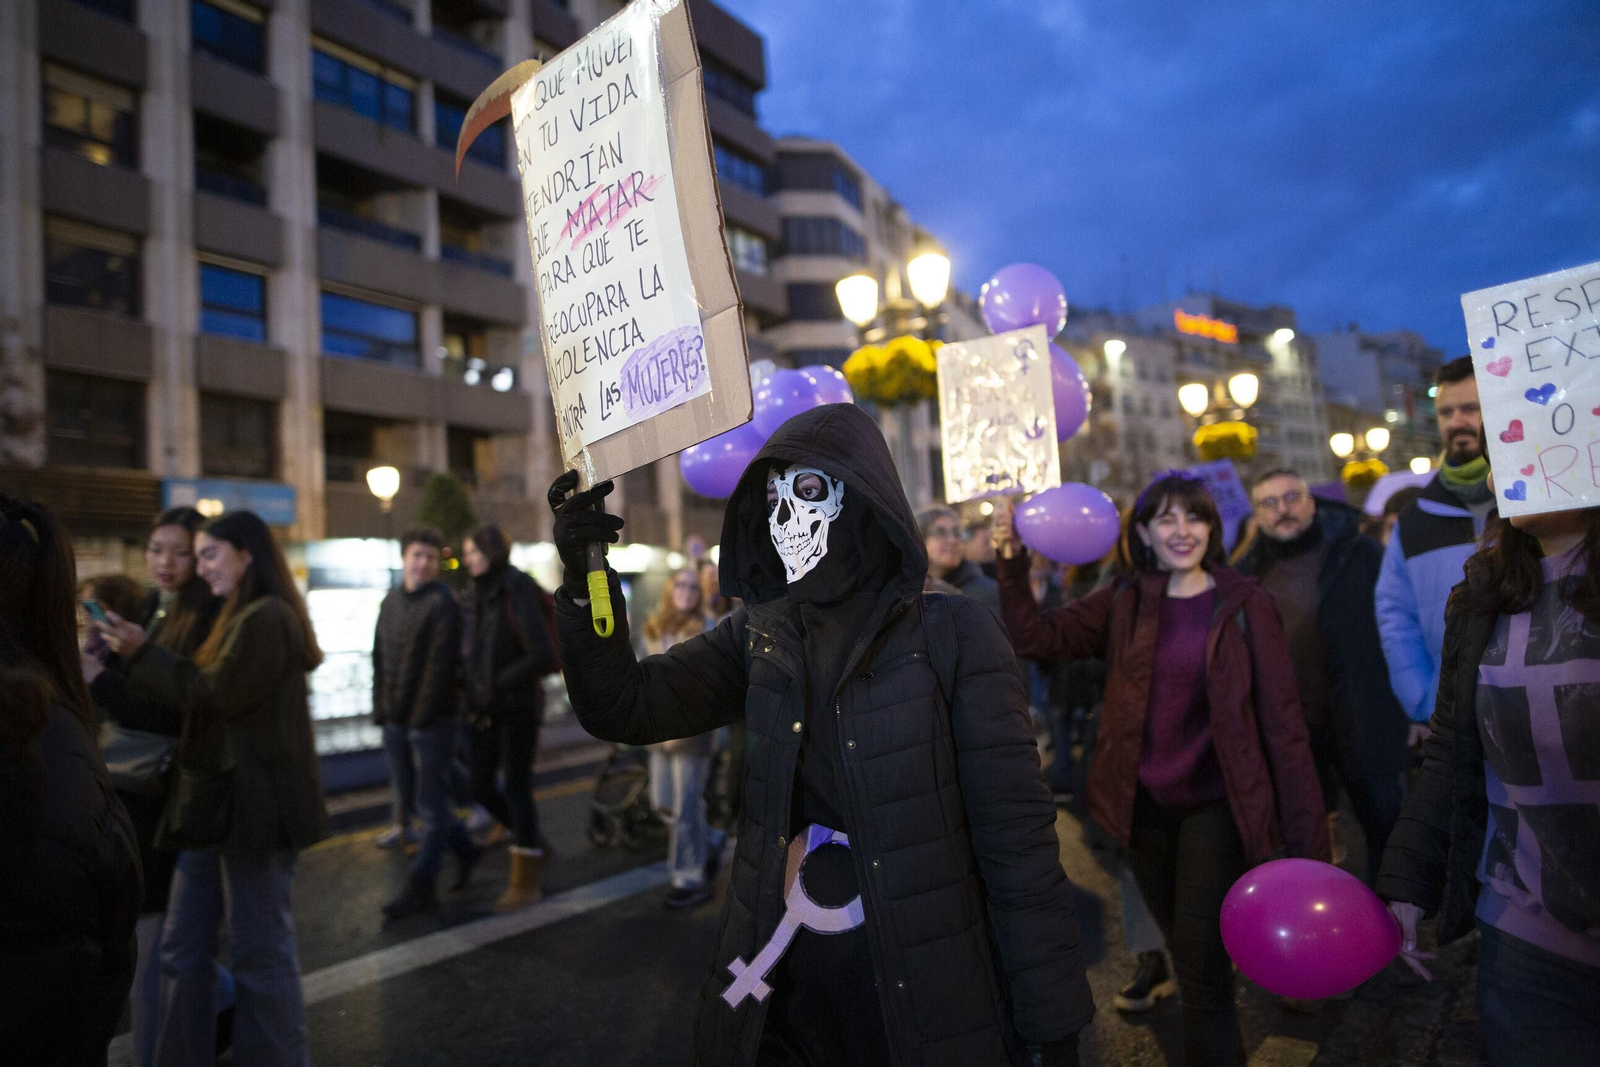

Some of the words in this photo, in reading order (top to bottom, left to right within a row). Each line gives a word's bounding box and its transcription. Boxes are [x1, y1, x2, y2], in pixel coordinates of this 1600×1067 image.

[534, 57, 566, 111] QUÉ
[538, 116, 559, 152] TU
[569, 73, 638, 133] VIDA
[527, 131, 624, 219] TENDRÍAN
[566, 170, 655, 239] MATAR
[540, 254, 577, 304] PARA
[582, 231, 614, 275] QUE
[623, 218, 649, 252] TE
[638, 264, 665, 301] LA
[1491, 277, 1600, 337] RESP
[551, 317, 646, 391] VIOLENCIA
[600, 380, 622, 422] LAS
[627, 334, 706, 410] MUJERES?
[1551, 402, 1575, 436] O
